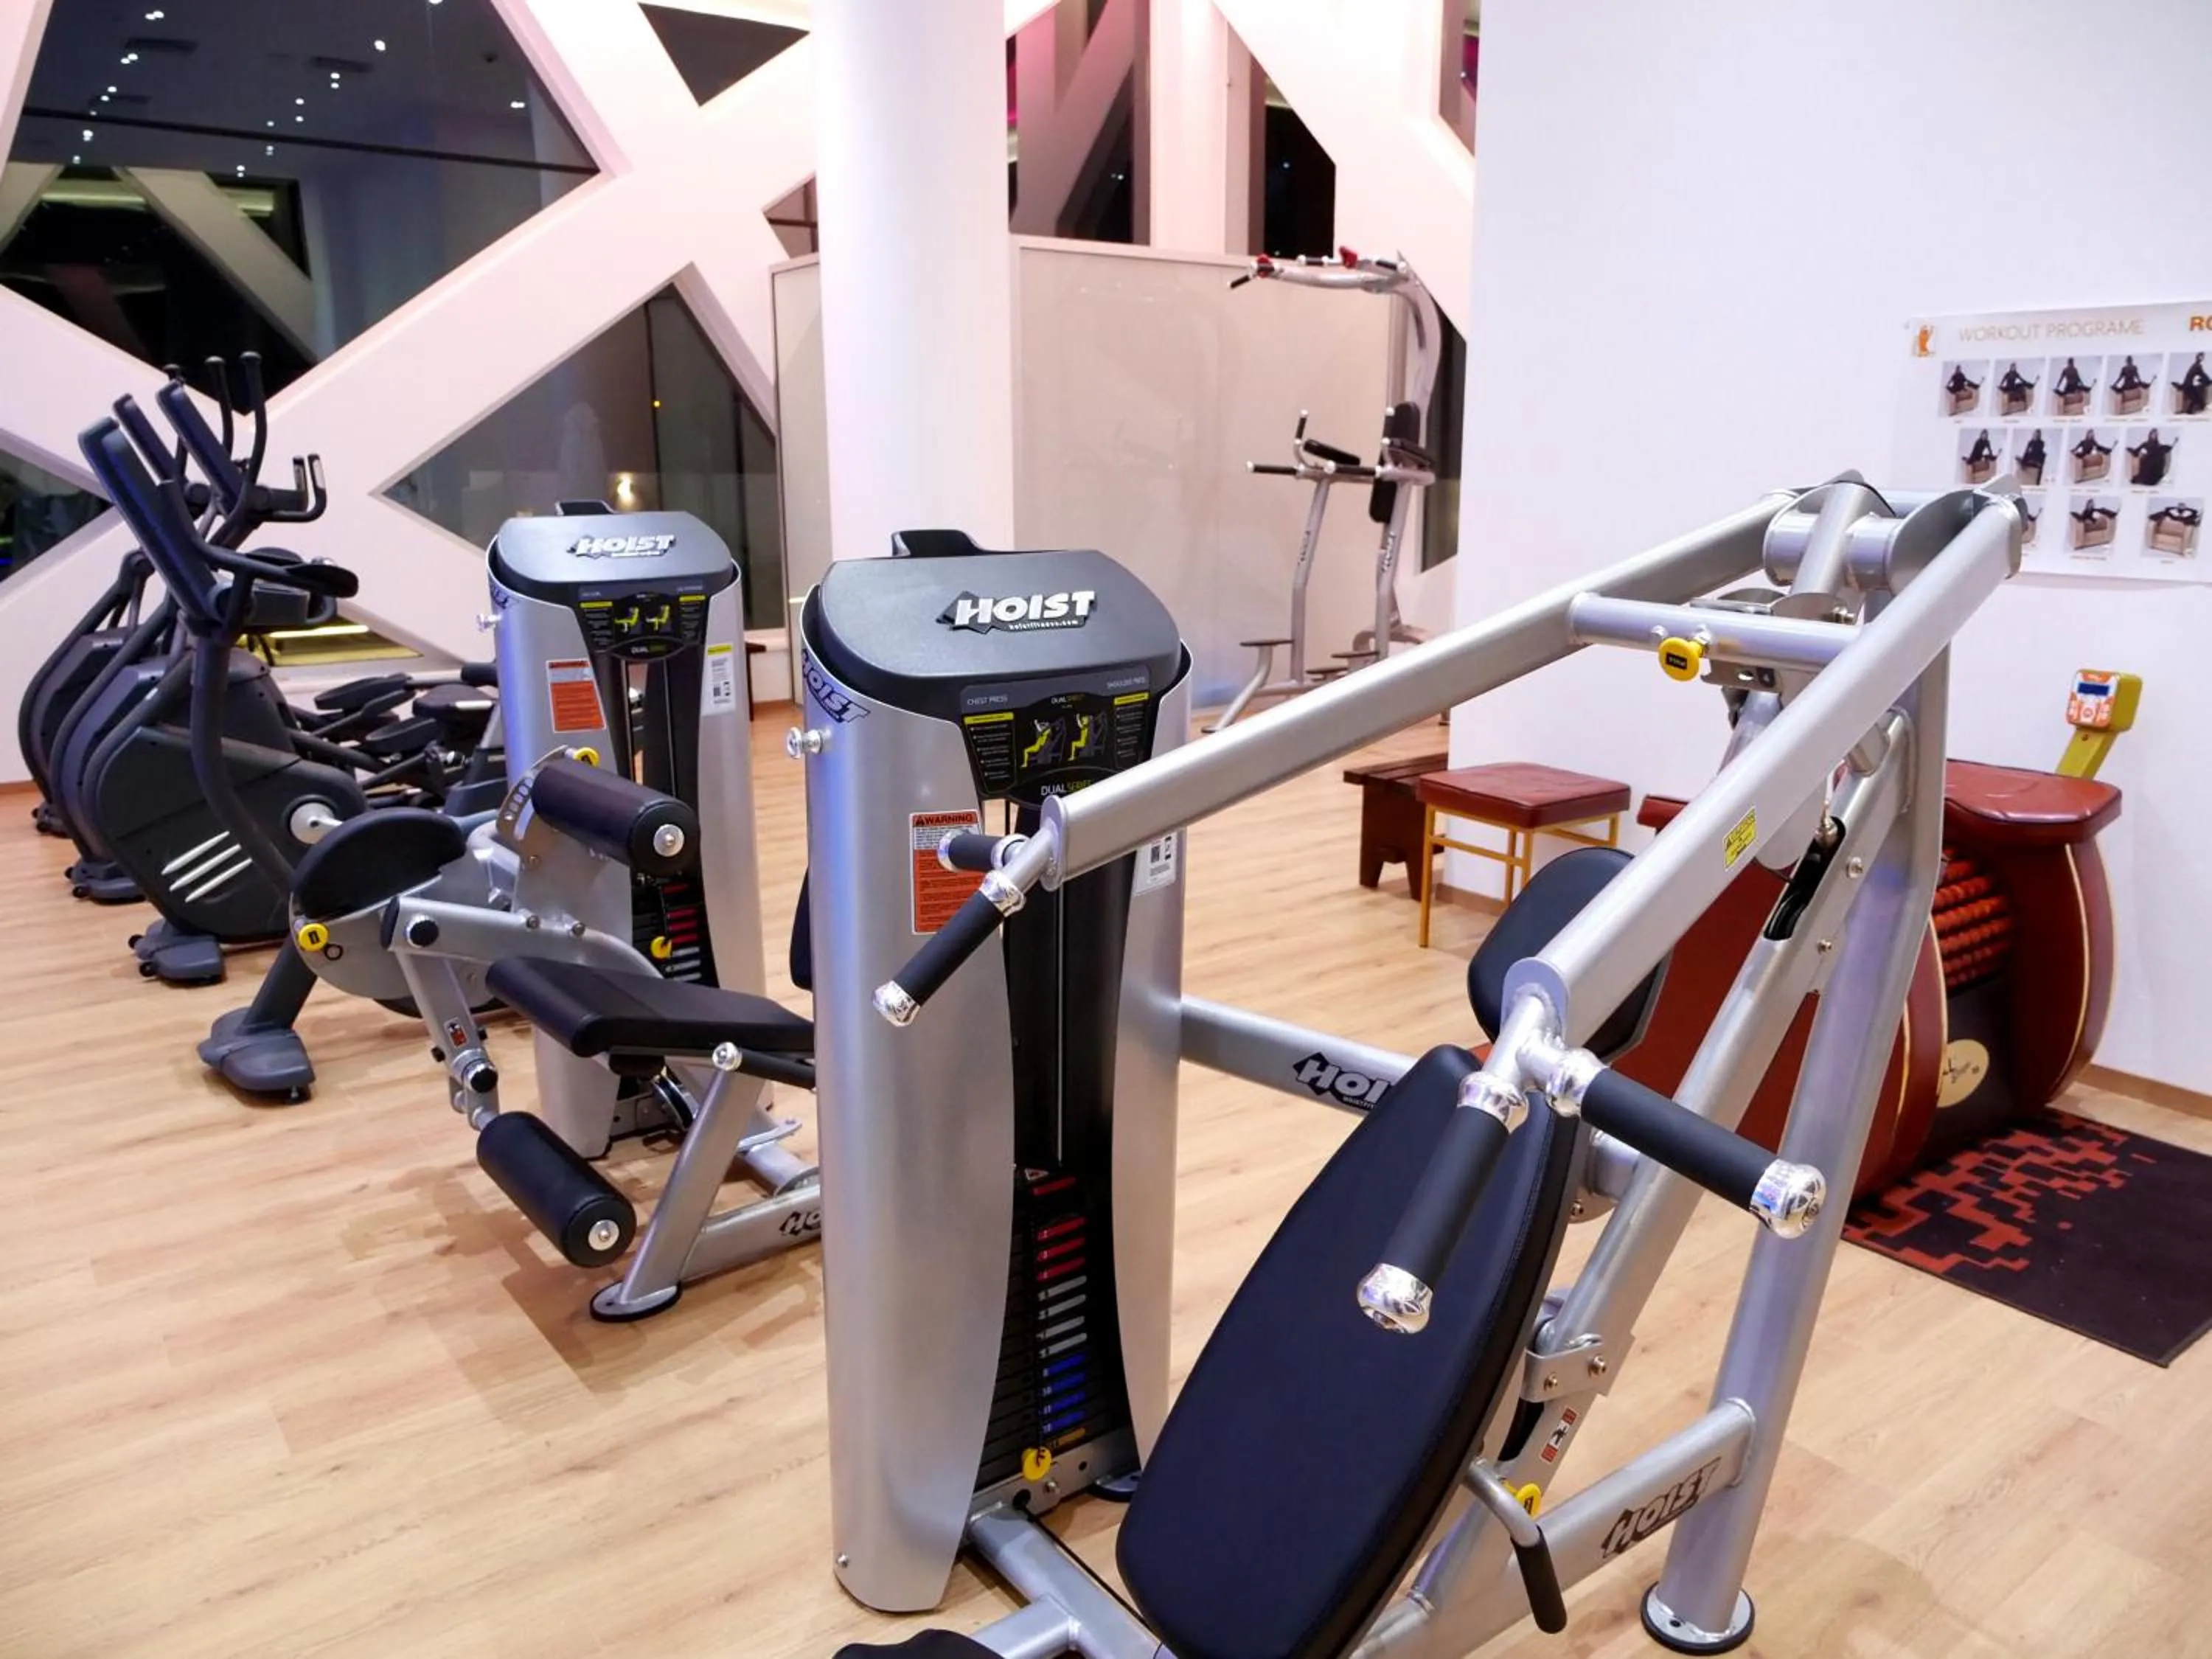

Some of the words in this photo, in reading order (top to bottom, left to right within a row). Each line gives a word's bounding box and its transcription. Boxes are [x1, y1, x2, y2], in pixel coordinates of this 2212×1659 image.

[1958, 324, 2040, 342] WORKOUT
[2045, 319, 2144, 338] PROGRAME
[577, 535, 675, 554] HOIST
[955, 591, 1095, 625] HOIST
[1040, 783, 1068, 796] DUAL
[925, 813, 973, 824] WARNING
[1297, 1059, 1391, 1103] HOI
[1601, 1456, 1722, 1559] HOIST
